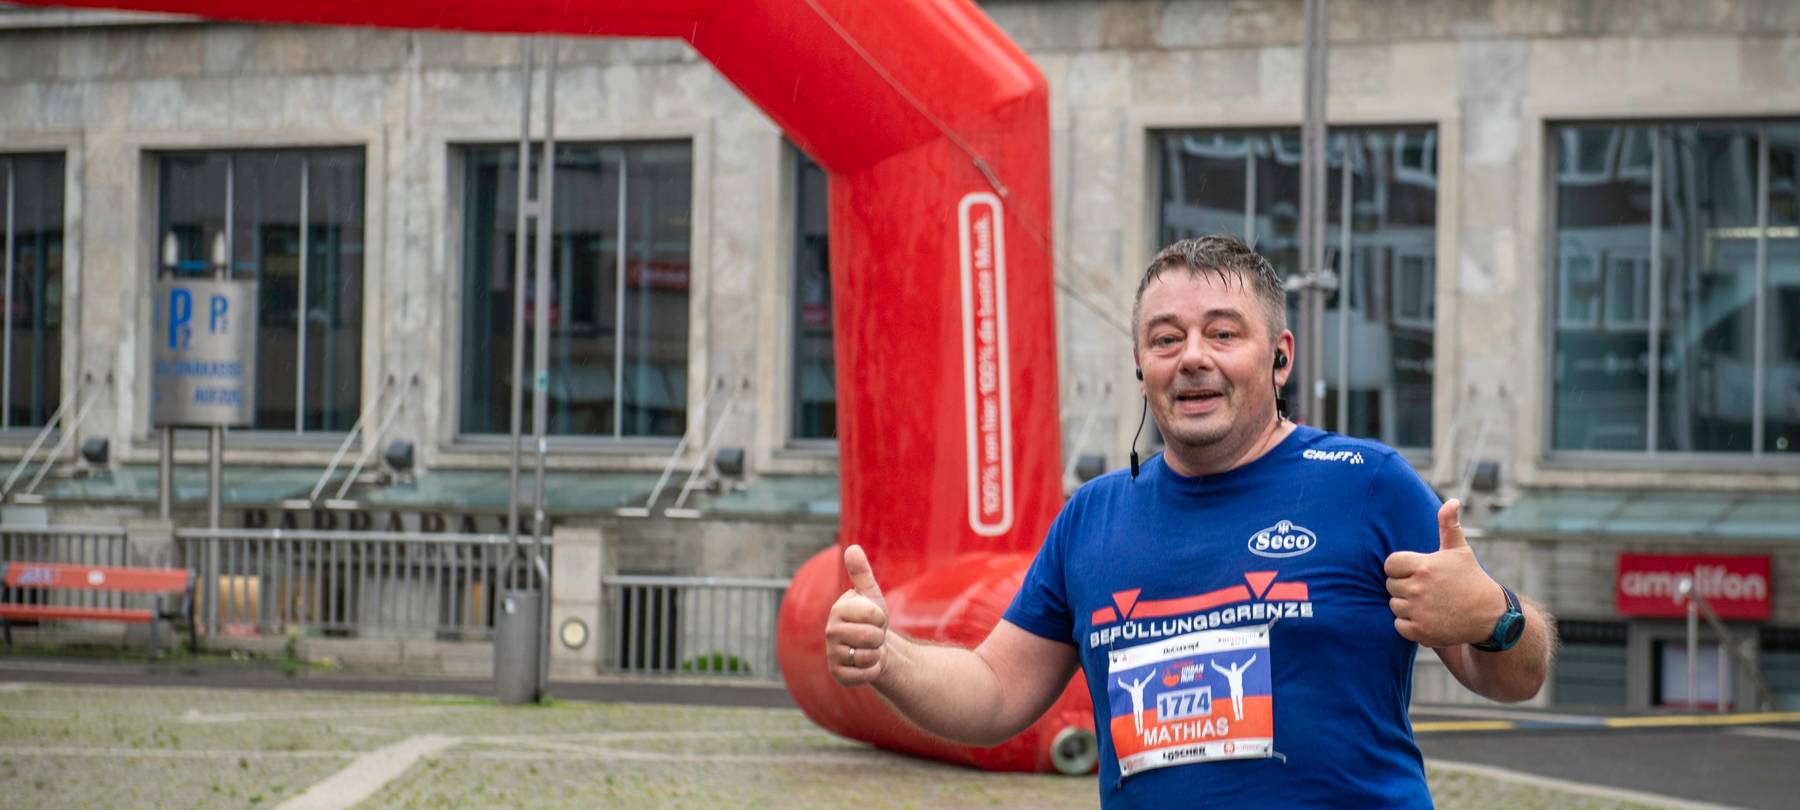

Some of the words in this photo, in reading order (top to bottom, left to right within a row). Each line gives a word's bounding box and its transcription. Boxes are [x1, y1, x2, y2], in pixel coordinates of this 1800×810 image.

[978, 345, 996, 396] 100%
[1303, 449, 1353, 461] CRAFT
[982, 464, 1000, 515] 100%
[1256, 532, 1310, 551] Seco
[1090, 602, 1313, 648] BEFÜLLUNGSGRENZE
[1159, 692, 1210, 719] 1774
[1144, 717, 1229, 746] MATHIAS
